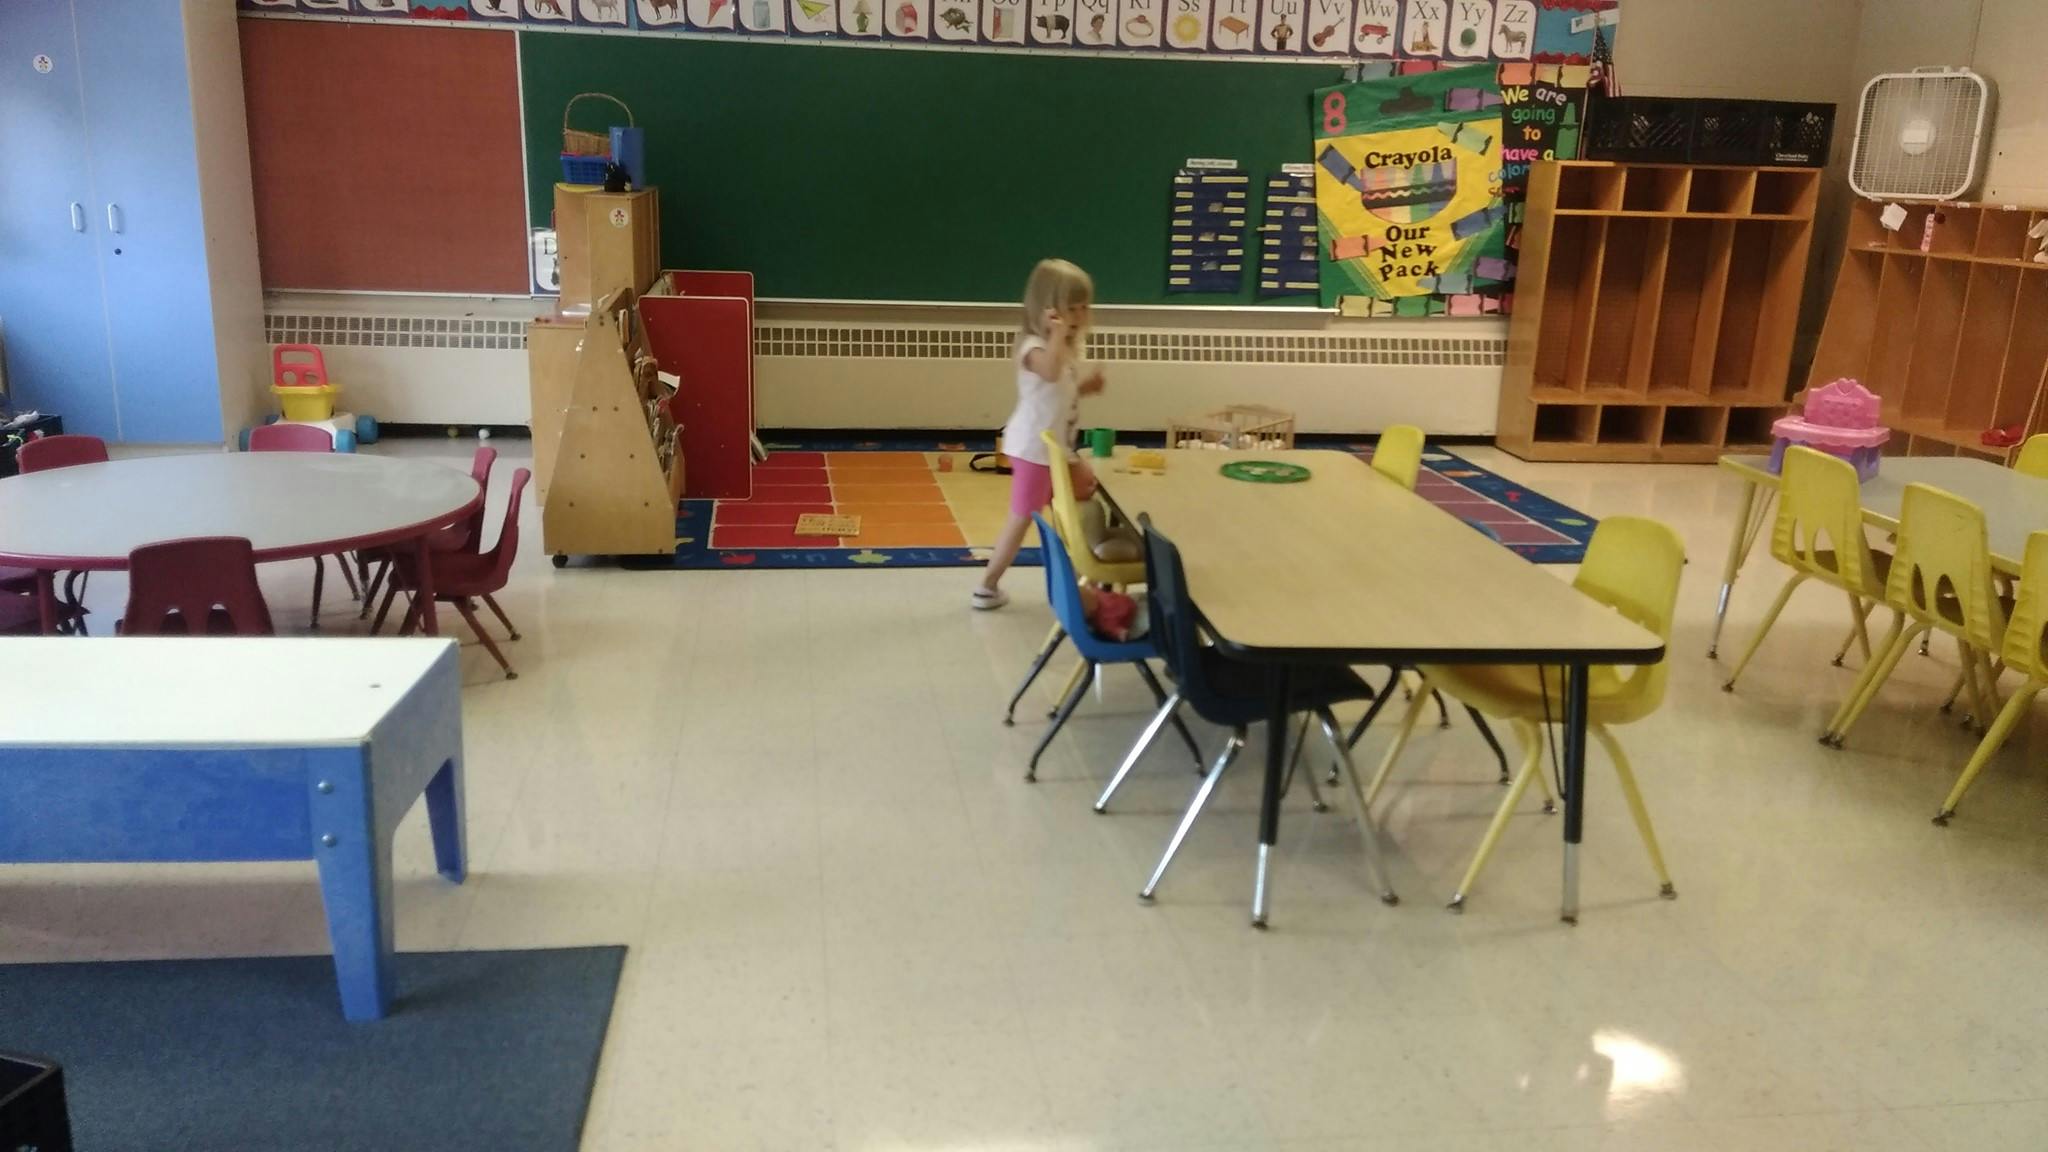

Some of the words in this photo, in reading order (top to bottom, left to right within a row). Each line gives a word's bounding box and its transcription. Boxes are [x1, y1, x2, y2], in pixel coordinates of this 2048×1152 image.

[1271, 0, 1298, 15] Uu
[1318, 0, 1346, 15] Vv
[1363, 0, 1395, 17] Ww
[1412, 0, 1440, 20] Xx
[1460, 2, 1488, 26] Yy
[1503, 4, 1529, 23] Zz
[1500, 86, 1529, 105] We
[1535, 88, 1567, 106] are
[1323, 92, 1346, 135] 8
[1511, 104, 1556, 124] going
[1522, 125, 1542, 140] to
[1365, 146, 1452, 169] Crayola
[1498, 144, 1539, 160] have
[1543, 149, 1554, 161] a
[1386, 225, 1430, 242] Our
[1380, 244, 1437, 263] New
[1379, 261, 1439, 281] Pack
